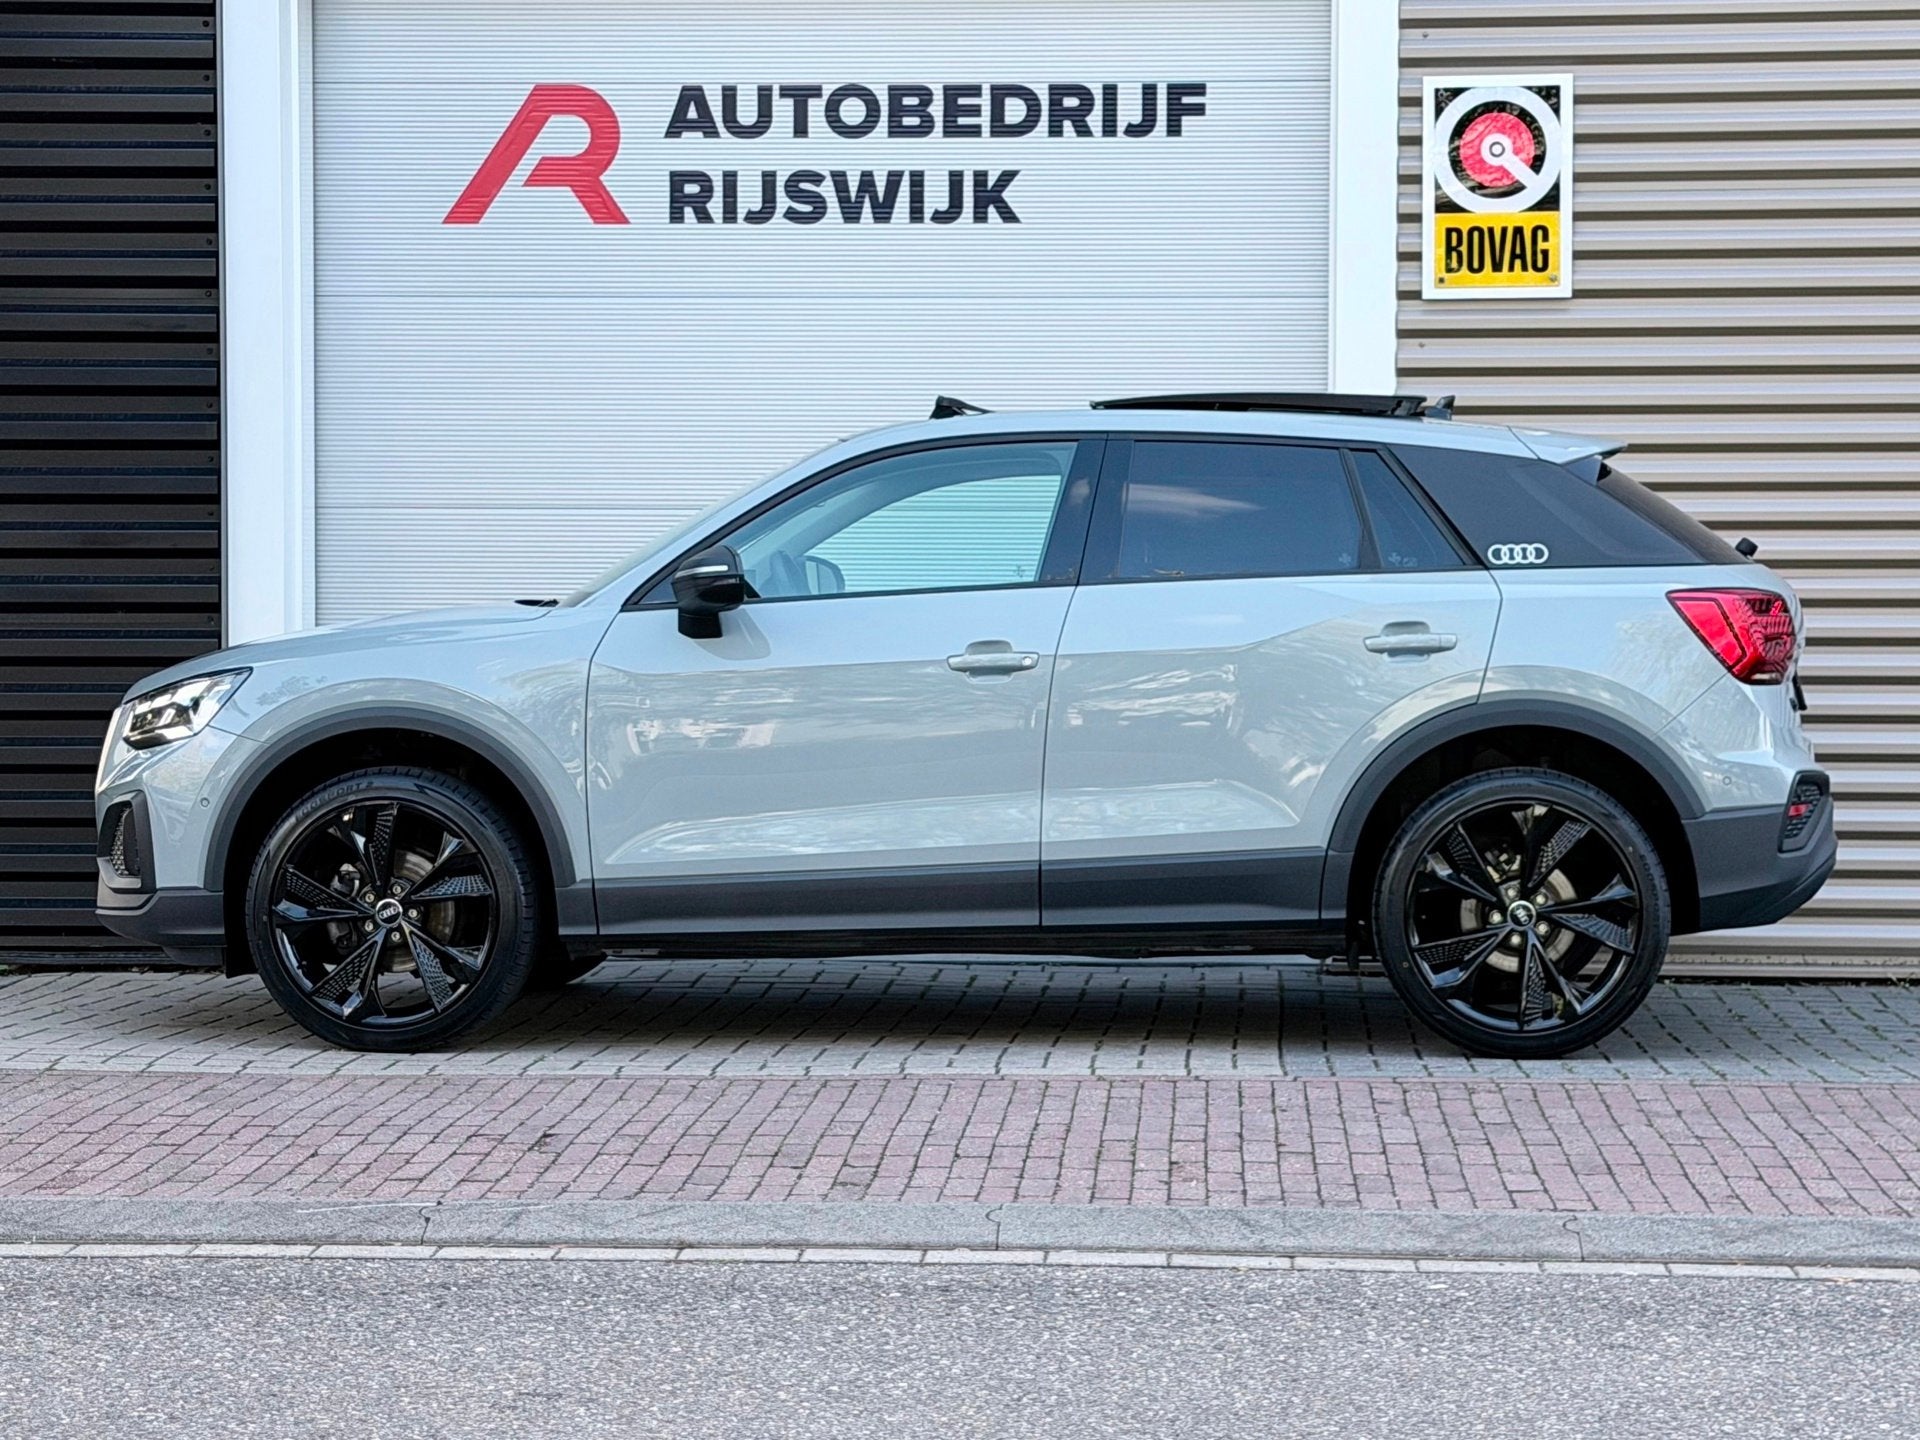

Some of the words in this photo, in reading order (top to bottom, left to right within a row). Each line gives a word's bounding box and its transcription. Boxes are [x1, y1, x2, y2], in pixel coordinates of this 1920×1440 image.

[664, 83, 1207, 139] AUTOBEDRIJF
[669, 169, 1020, 225] RIJSWIJK
[1445, 224, 1550, 274] BOVAG
